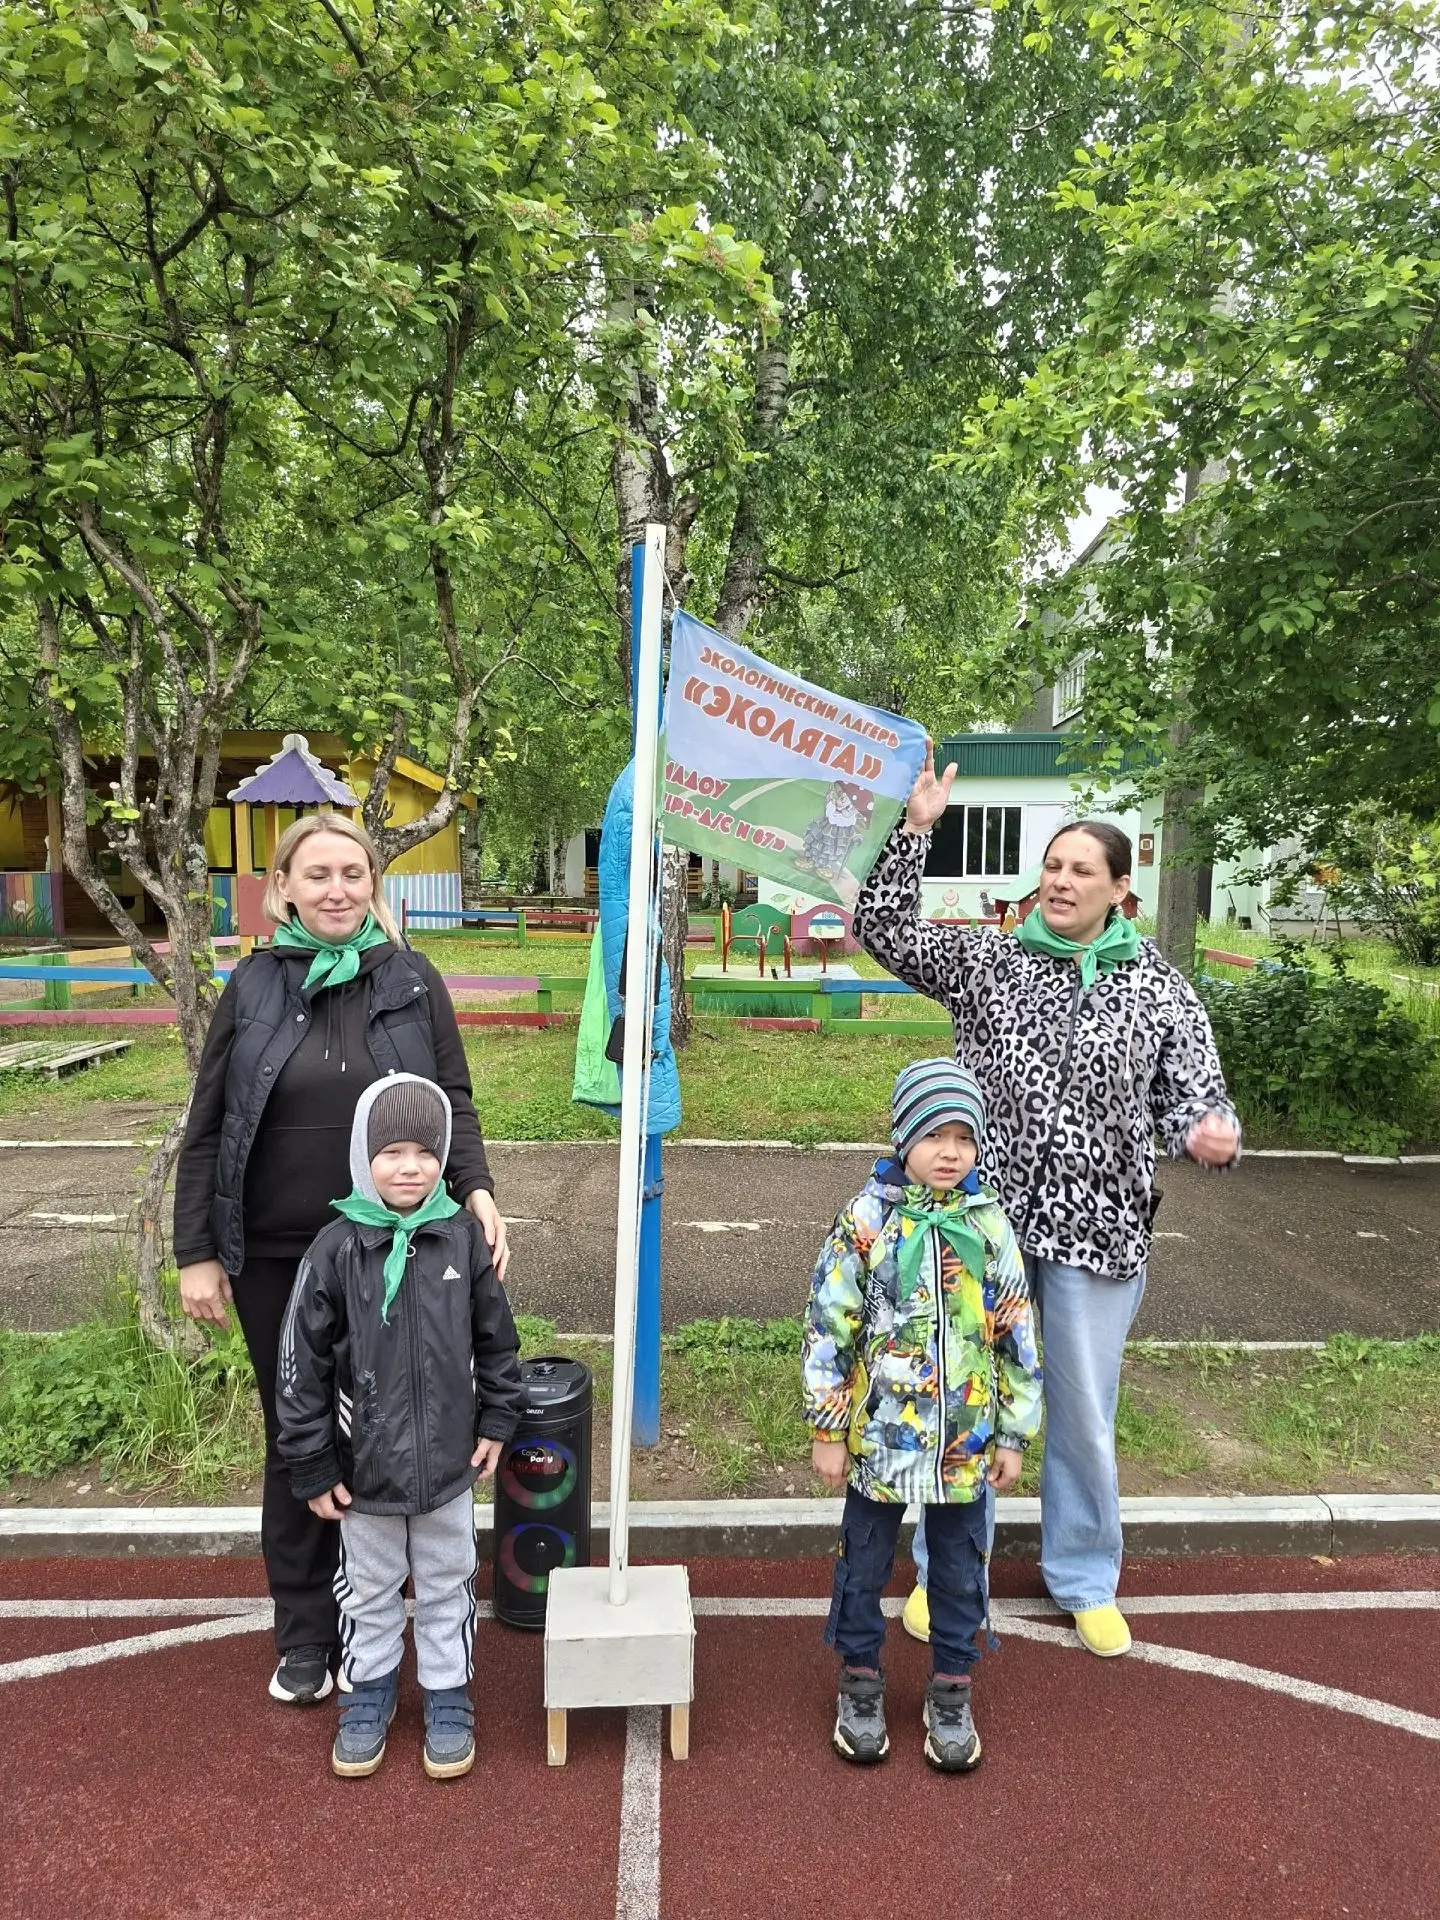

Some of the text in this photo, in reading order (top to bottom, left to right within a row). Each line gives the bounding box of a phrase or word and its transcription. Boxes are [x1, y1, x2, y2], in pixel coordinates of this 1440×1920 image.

[683, 676, 883, 780] «ЭКОЛЯТА»
[700, 646, 900, 749] ЭКОЛОГИЧЕСКИЙ ЛАГЕРЬ
